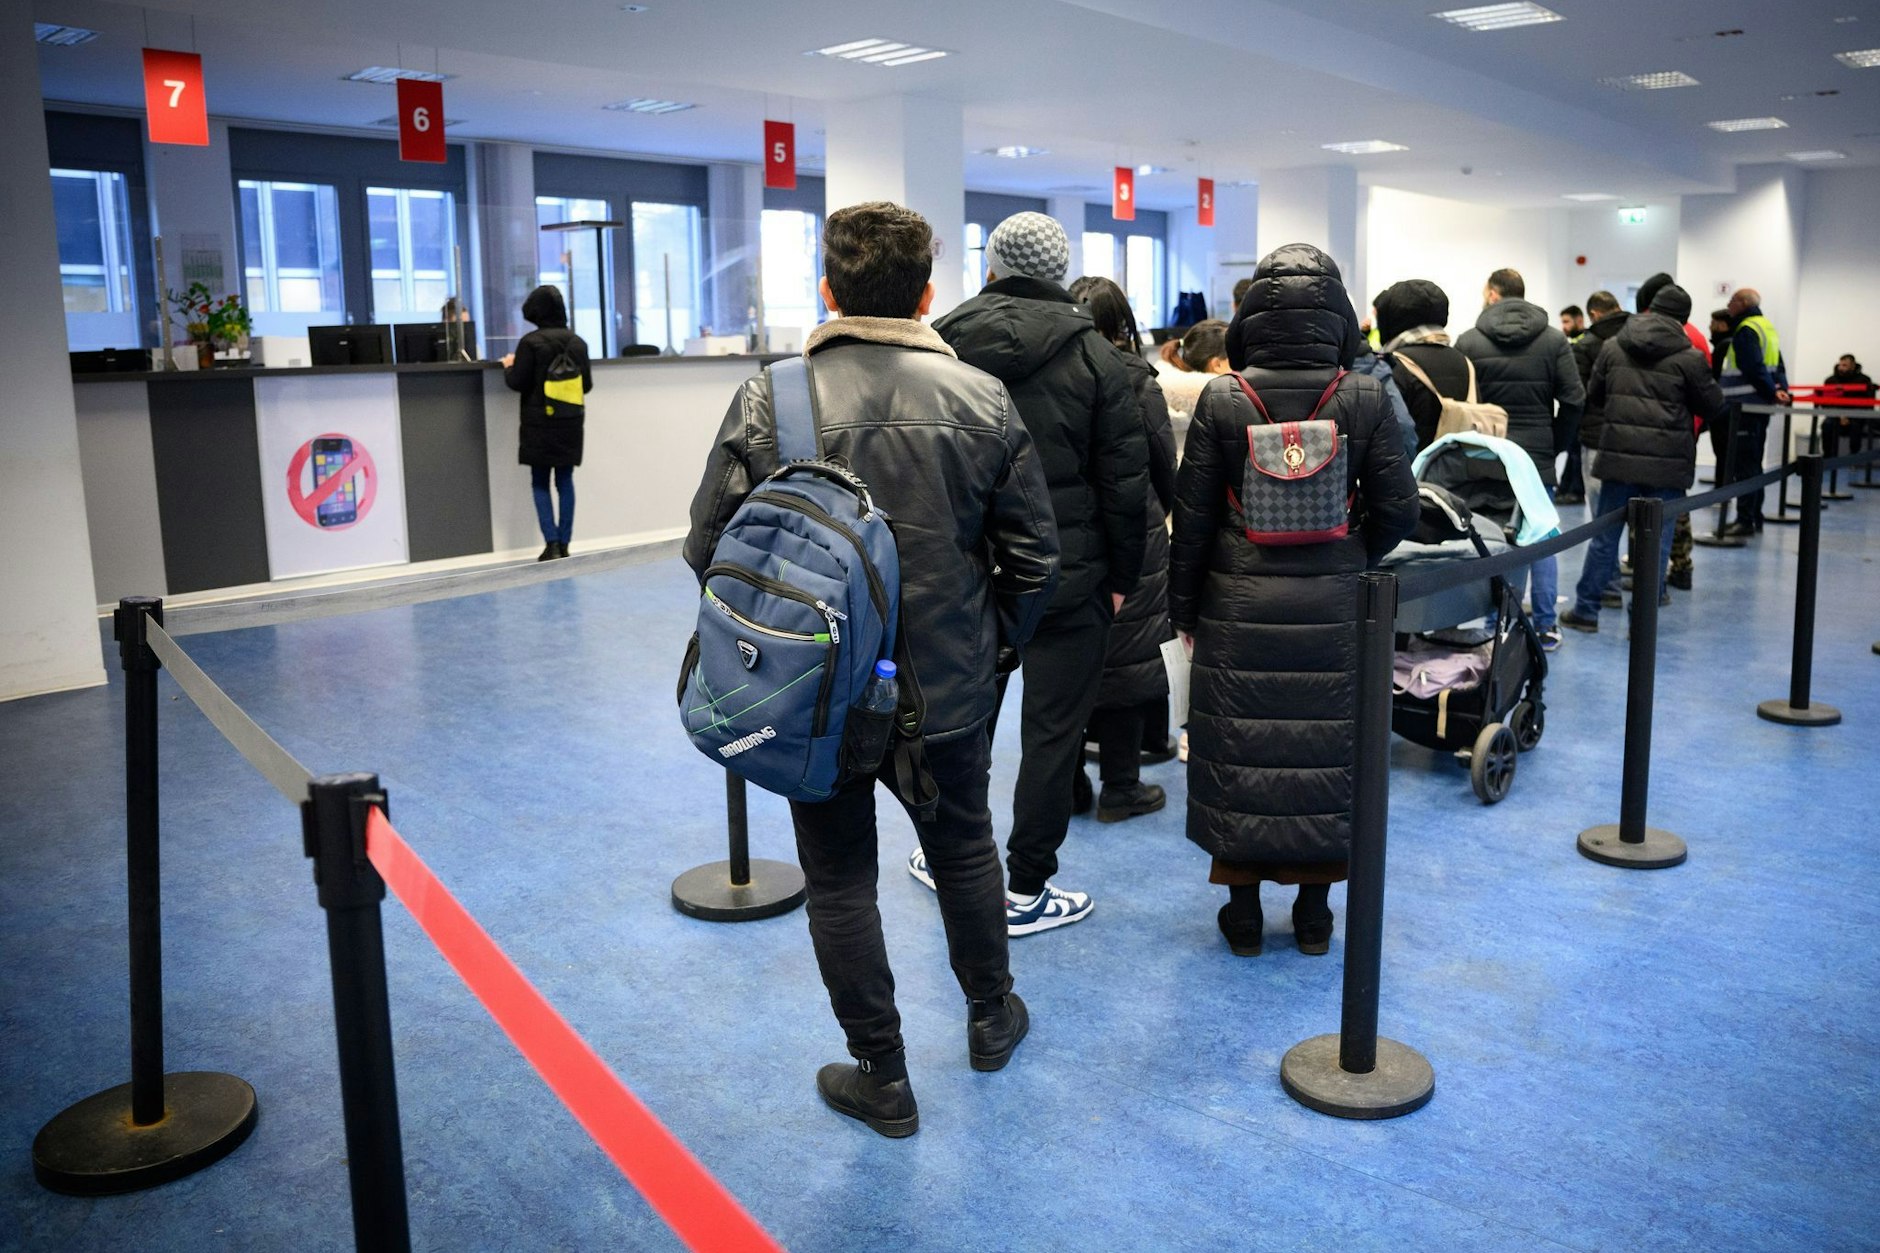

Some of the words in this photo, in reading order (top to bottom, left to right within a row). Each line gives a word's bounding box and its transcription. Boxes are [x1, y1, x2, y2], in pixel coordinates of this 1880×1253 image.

[163, 79, 186, 108] 7
[413, 106, 431, 133] 6
[773, 142, 787, 163] 5
[1119, 183, 1130, 201] 3
[1202, 193, 1211, 209] 2
[718, 725, 777, 759] BIAOWANG
